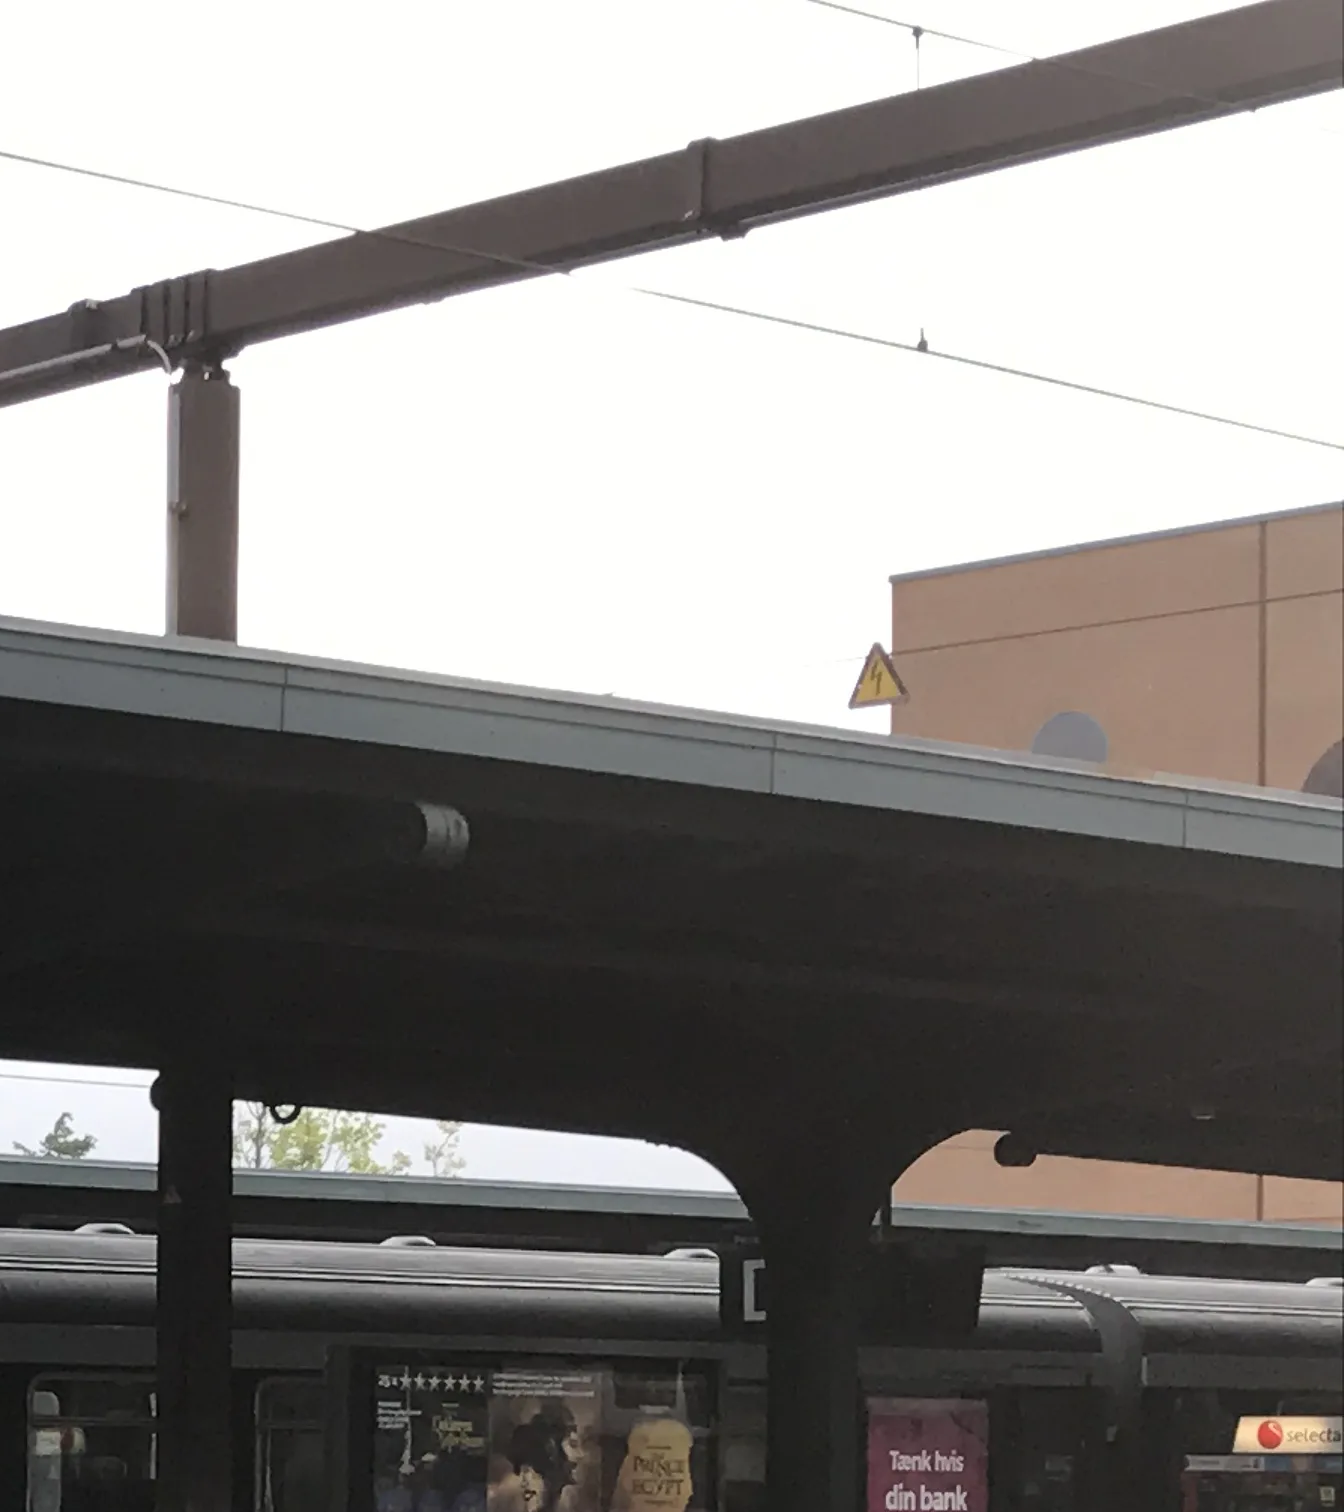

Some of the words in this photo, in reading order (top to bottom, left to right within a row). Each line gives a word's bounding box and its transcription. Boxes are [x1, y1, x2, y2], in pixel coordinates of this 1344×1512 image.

[1286, 1428, 1342, 1442] selecta
[889, 1449, 932, 1472] Tænk
[935, 1449, 964, 1472] hvis
[632, 1478, 685, 1496] EGYPT
[885, 1484, 916, 1511] din
[919, 1484, 967, 1512] bank
